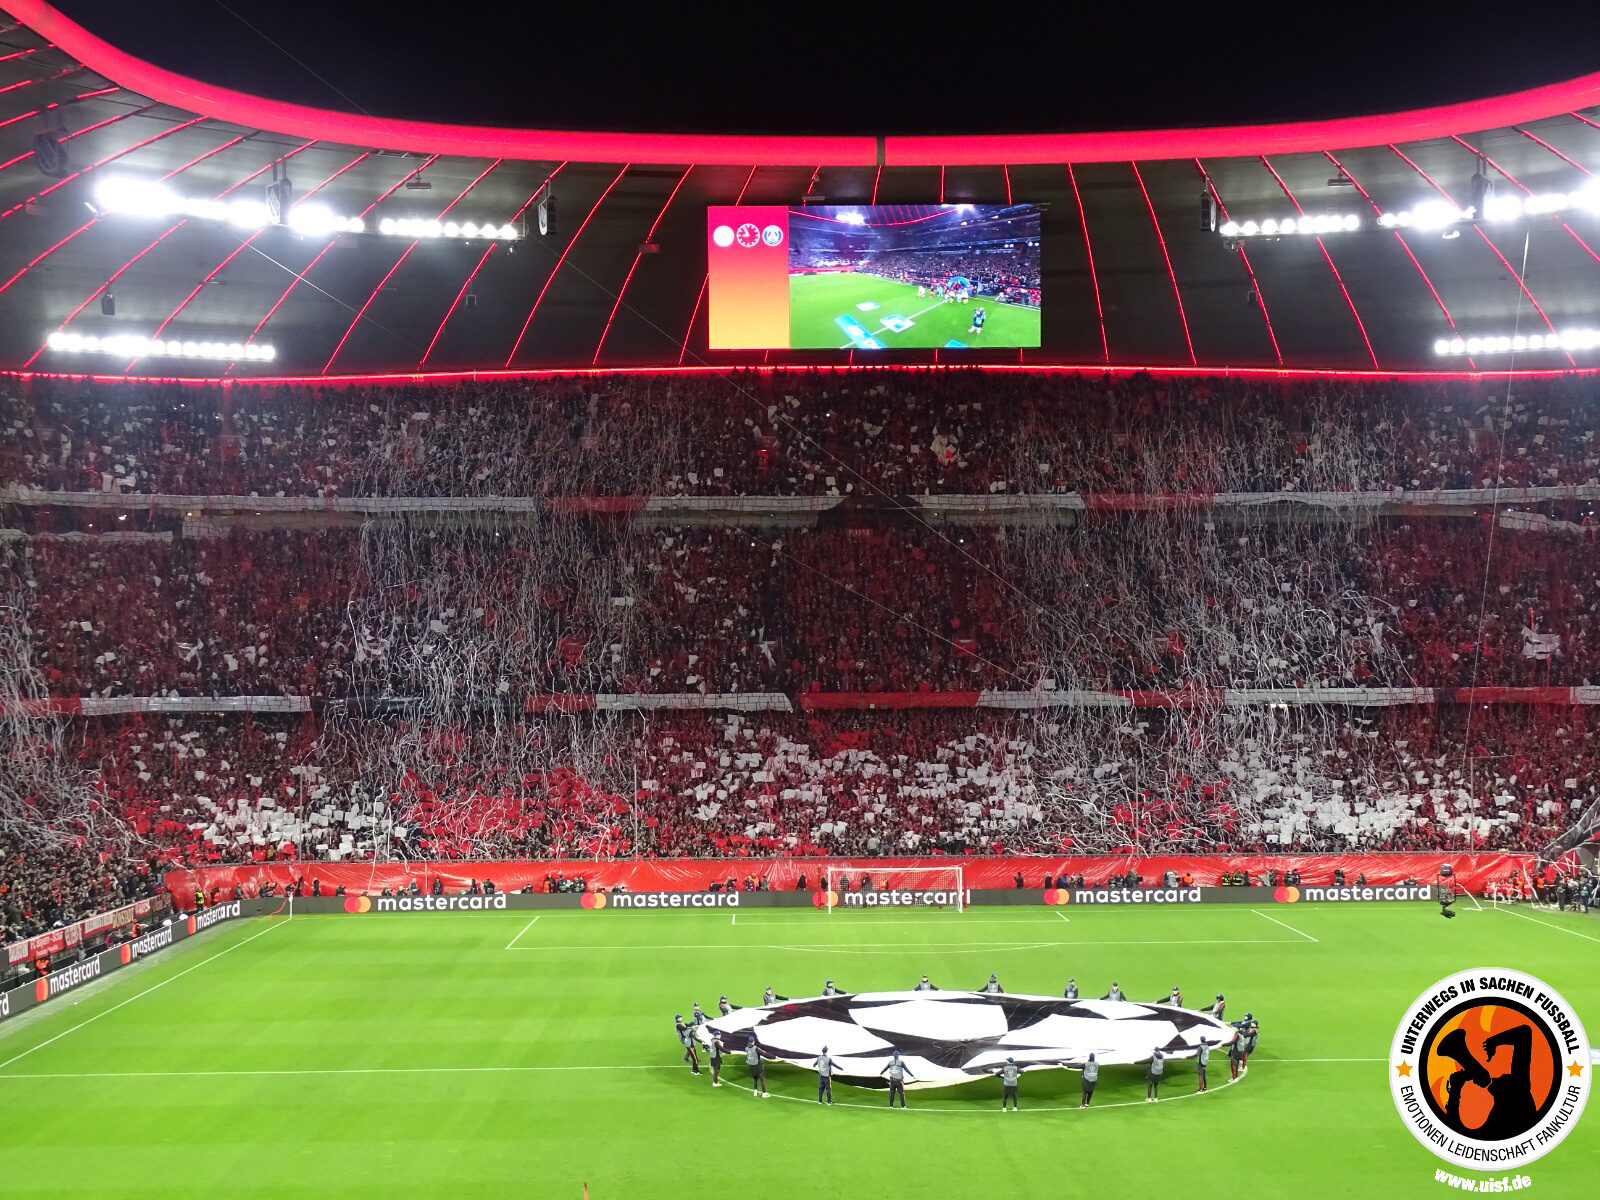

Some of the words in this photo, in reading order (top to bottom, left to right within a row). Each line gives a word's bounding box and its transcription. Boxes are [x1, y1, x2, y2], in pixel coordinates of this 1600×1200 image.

[612, 892, 739, 907] mastercard
[1075, 887, 1201, 902] mastercard
[1305, 885, 1431, 900] mastercard
[377, 893, 506, 911] mastercard
[197, 900, 240, 930] mastercard
[132, 926, 172, 958] mastercard
[50, 955, 100, 995] mastercard
